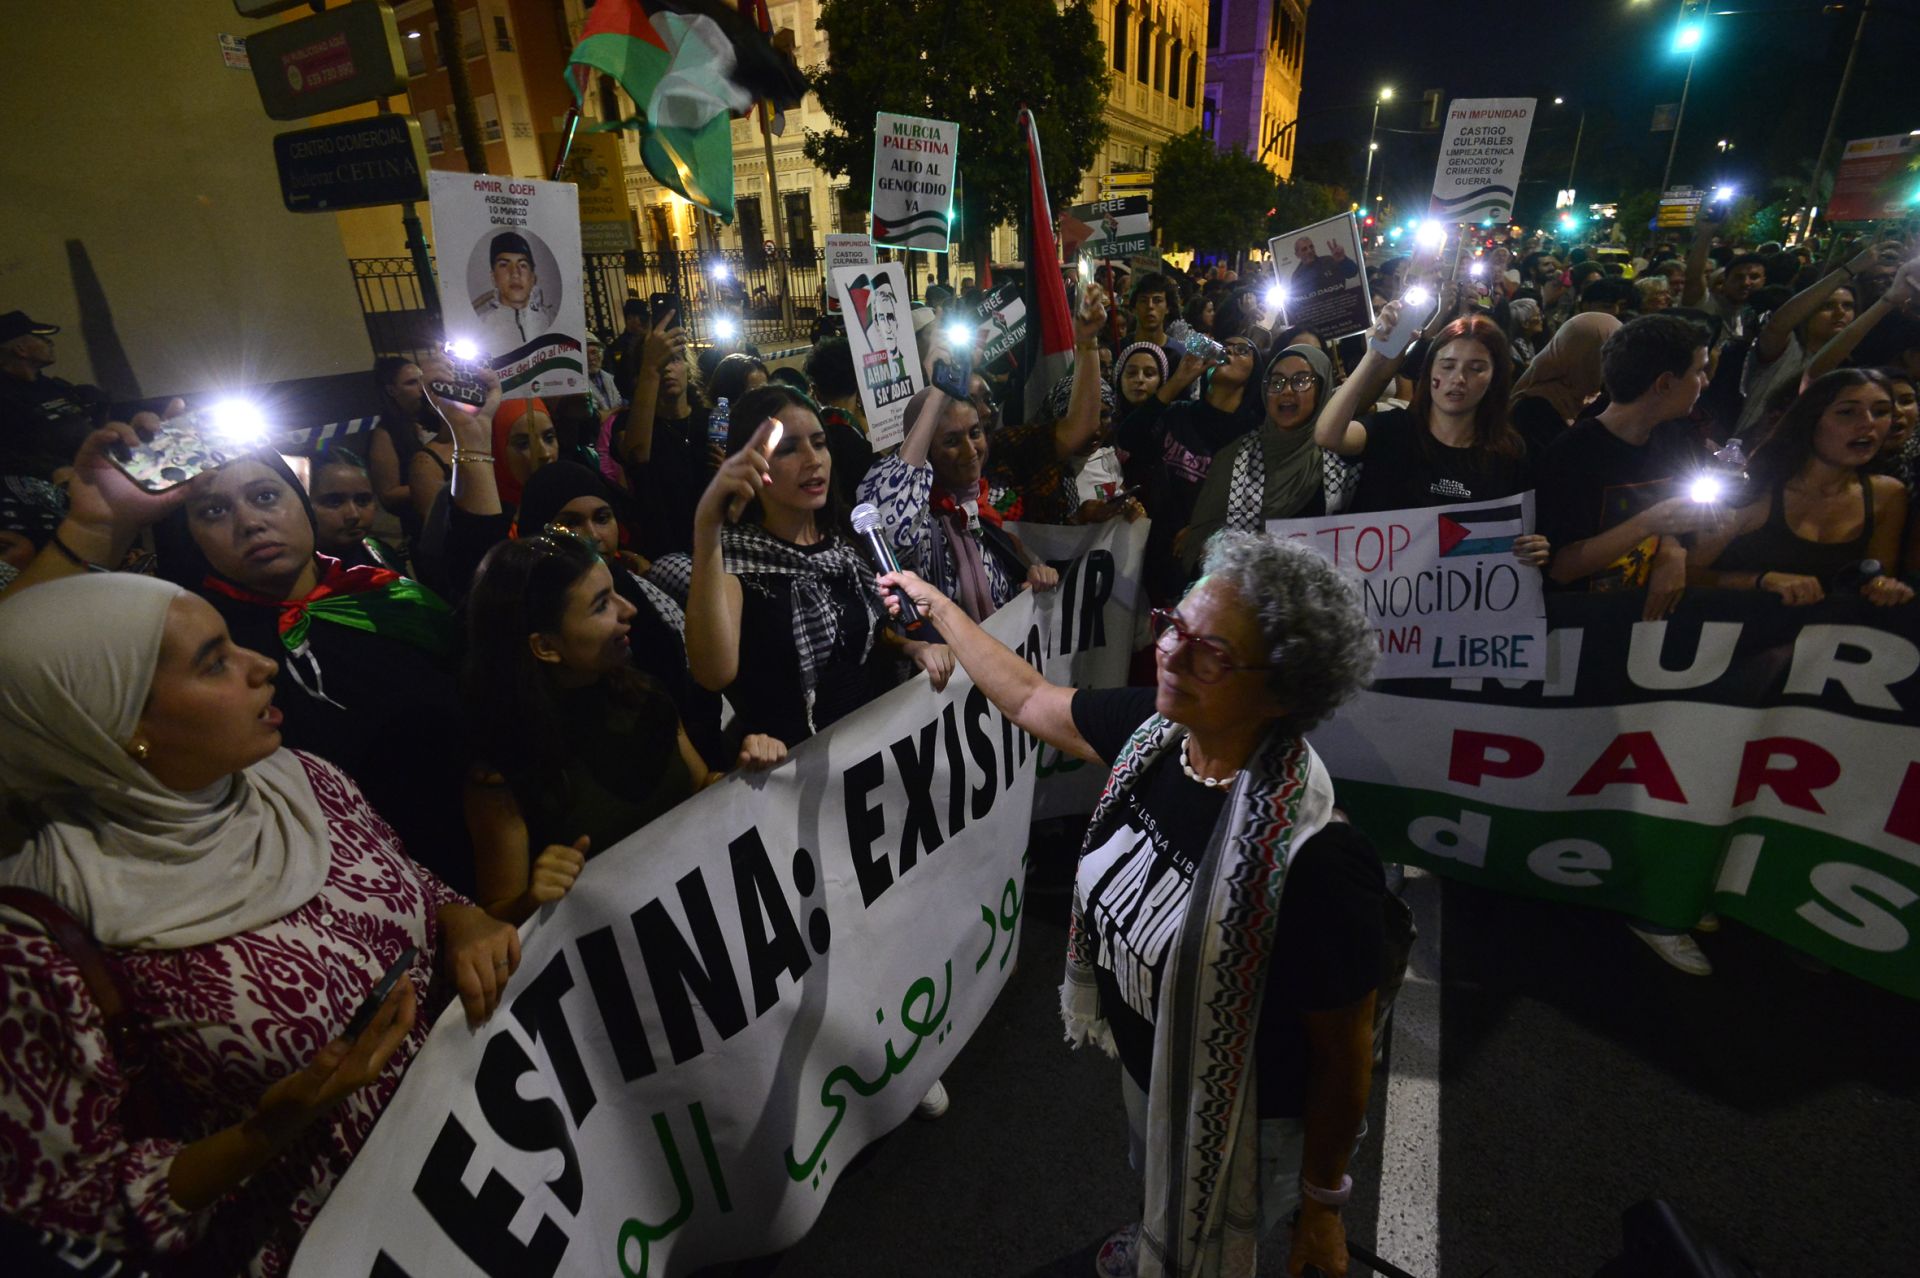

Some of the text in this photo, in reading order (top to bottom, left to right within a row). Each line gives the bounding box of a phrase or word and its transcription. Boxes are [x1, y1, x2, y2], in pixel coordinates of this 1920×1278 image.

[1452, 109, 1527, 119] FIN IMPUNIDAD
[893, 122, 940, 140] MURCIA
[1460, 126, 1506, 136] CASTIGO
[289, 127, 407, 159] CENTRO COMERCIAL
[883, 135, 949, 155] PALESTINA
[1453, 136, 1514, 146] CULPABLES
[1446, 148, 1483, 156] LIMPIEZA
[336, 156, 418, 184] CETINA
[891, 159, 941, 176] ALTO AL
[1448, 157, 1505, 167] GENOCIDIO y
[1492, 166, 1503, 175] de
[474, 180, 535, 196] AMIR ODEH
[878, 177, 947, 197] GENOCIDIO
[1455, 177, 1492, 185] GUERRA
[485, 195, 529, 206] ASESINADO
[905, 199, 919, 213] YA
[1091, 199, 1127, 214] FREE
[489, 206, 527, 216] 10 MARZO
[977, 289, 1003, 317] FREE
[867, 361, 901, 386] AHMD
[1288, 523, 1411, 574] TOP
[1407, 810, 1614, 888] de
[370, 825, 831, 1278] ESTINA:
[784, 959, 952, 1191] يعني
